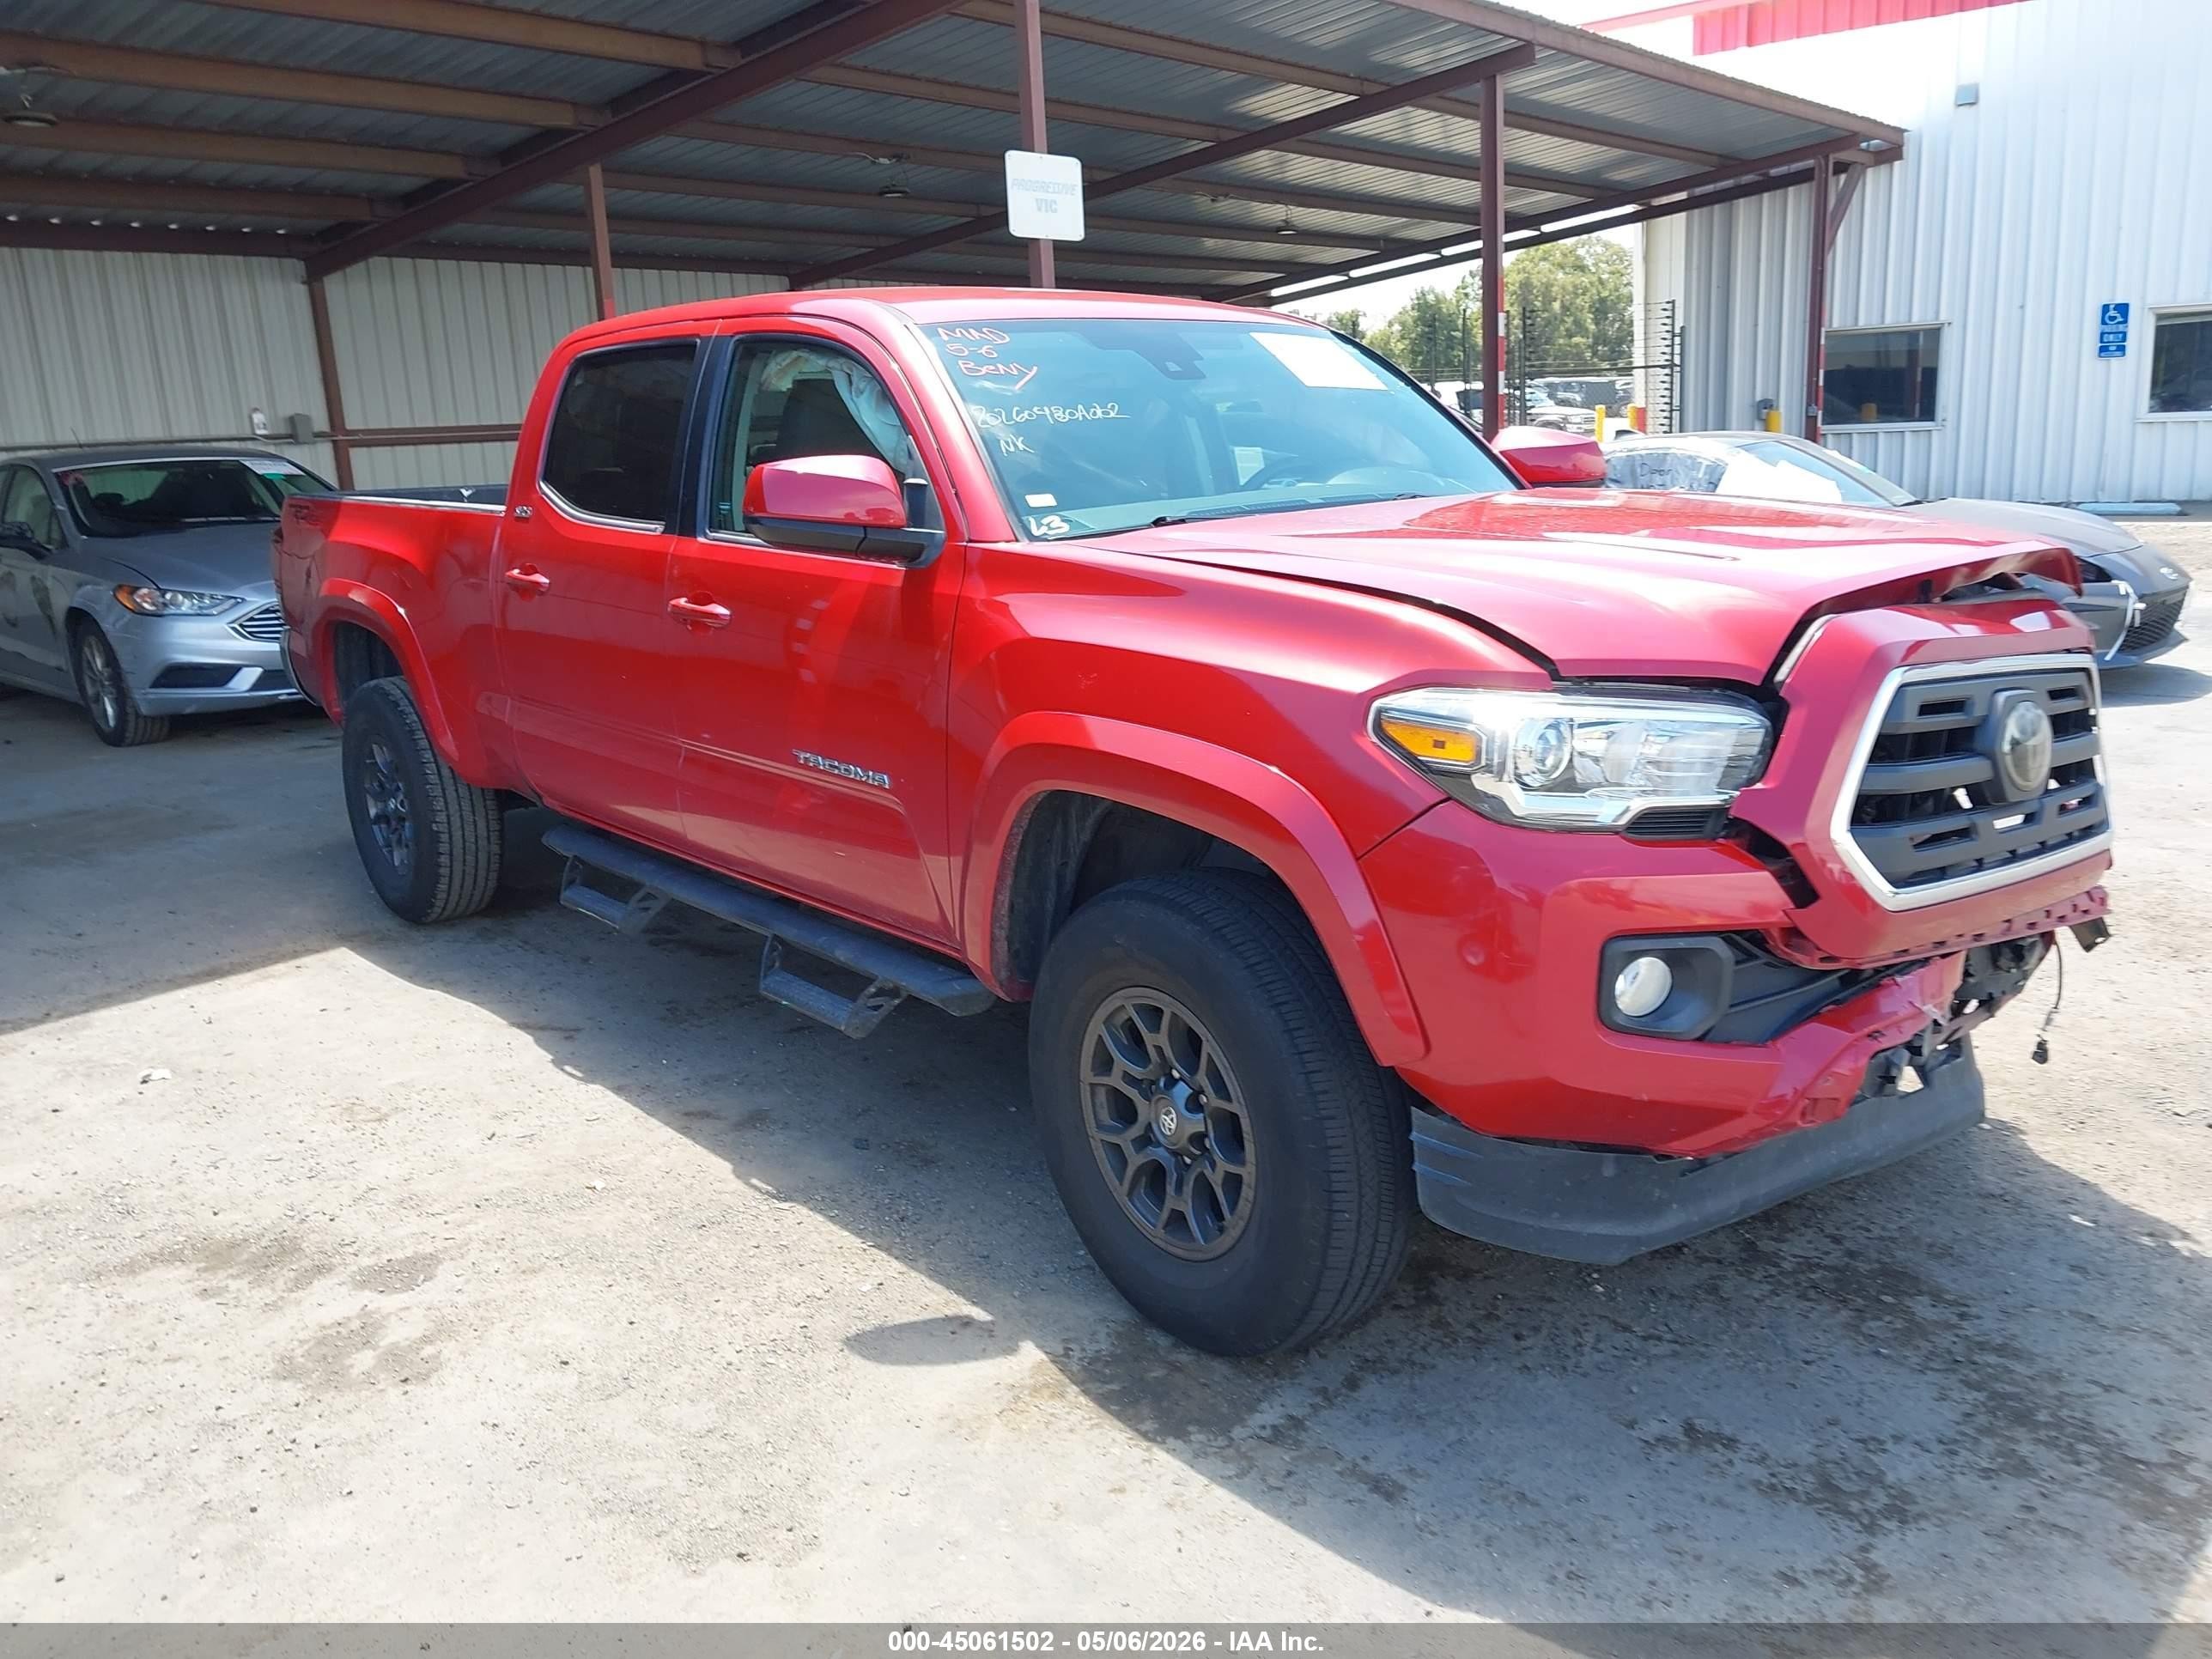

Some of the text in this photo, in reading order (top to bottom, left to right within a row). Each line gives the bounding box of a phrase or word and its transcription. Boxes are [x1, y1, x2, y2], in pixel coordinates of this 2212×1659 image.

[1035, 198, 1058, 213] VIC
[937, 327, 1010, 343] MAD
[945, 343, 998, 358] 5-6
[999, 434, 1035, 457] NK
[792, 749, 890, 789] TACOMA
